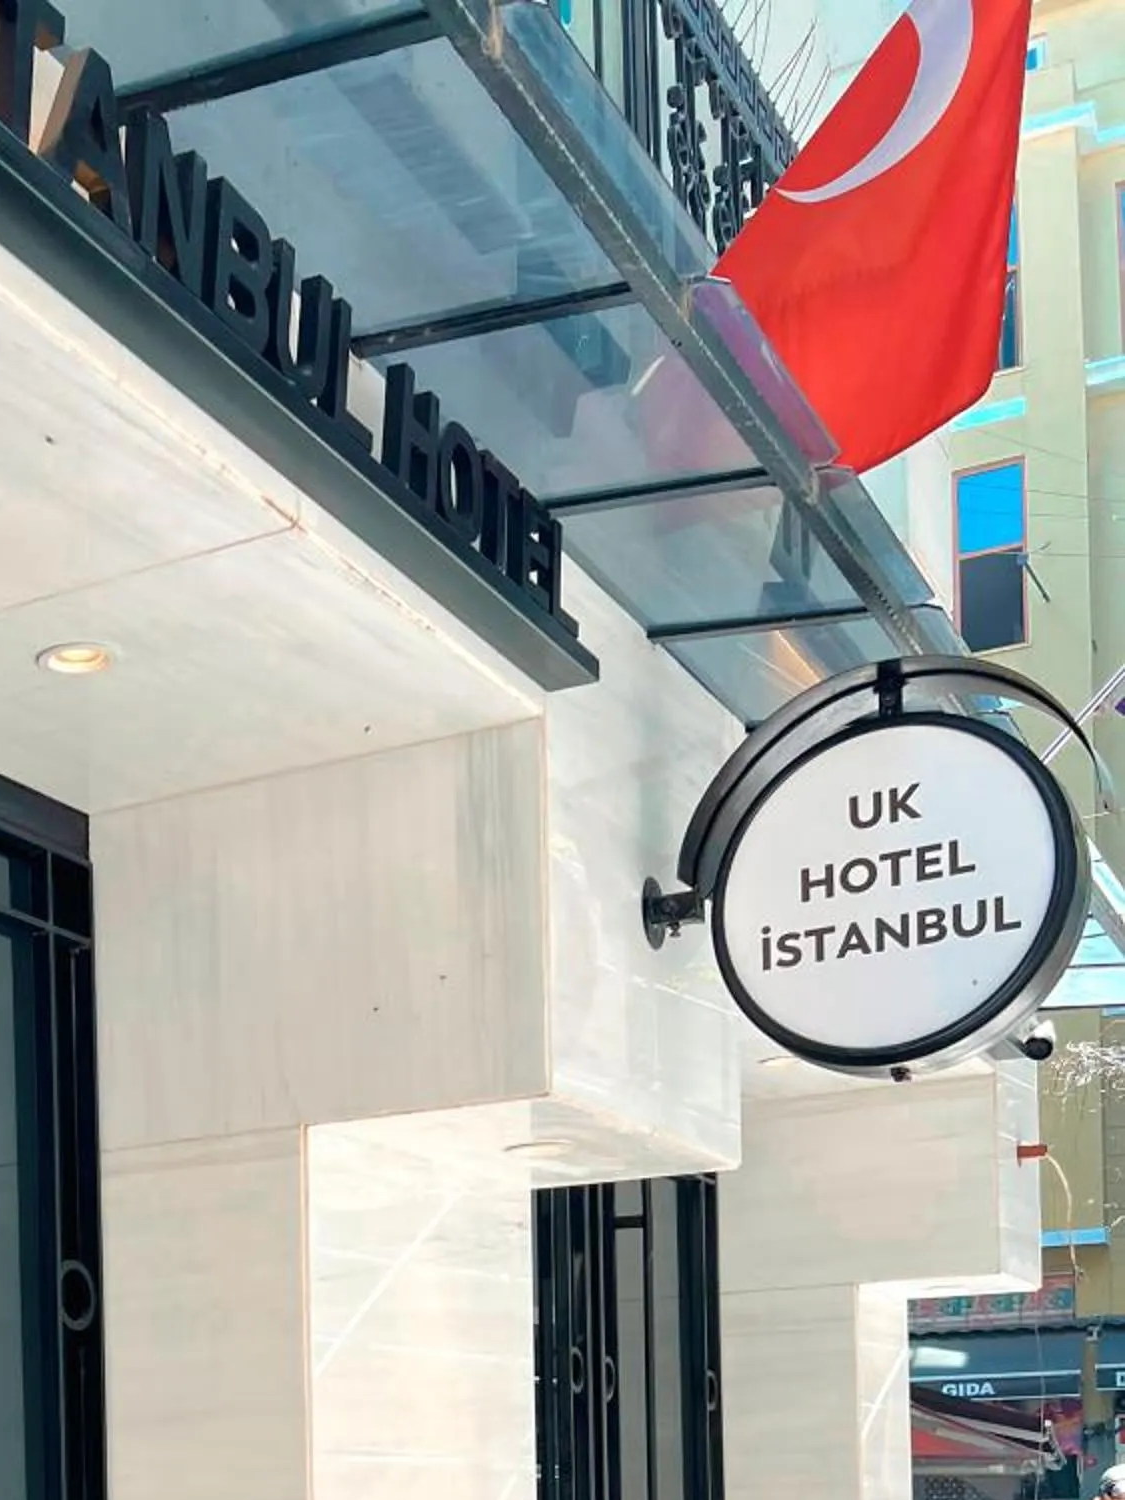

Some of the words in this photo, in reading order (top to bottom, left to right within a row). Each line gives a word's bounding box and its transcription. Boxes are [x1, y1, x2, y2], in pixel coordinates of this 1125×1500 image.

[382, 363, 578, 637] HOTEL
[848, 783, 921, 829] UK
[800, 840, 976, 902] HOTEL
[941, 1381, 995, 1397] GIDA
